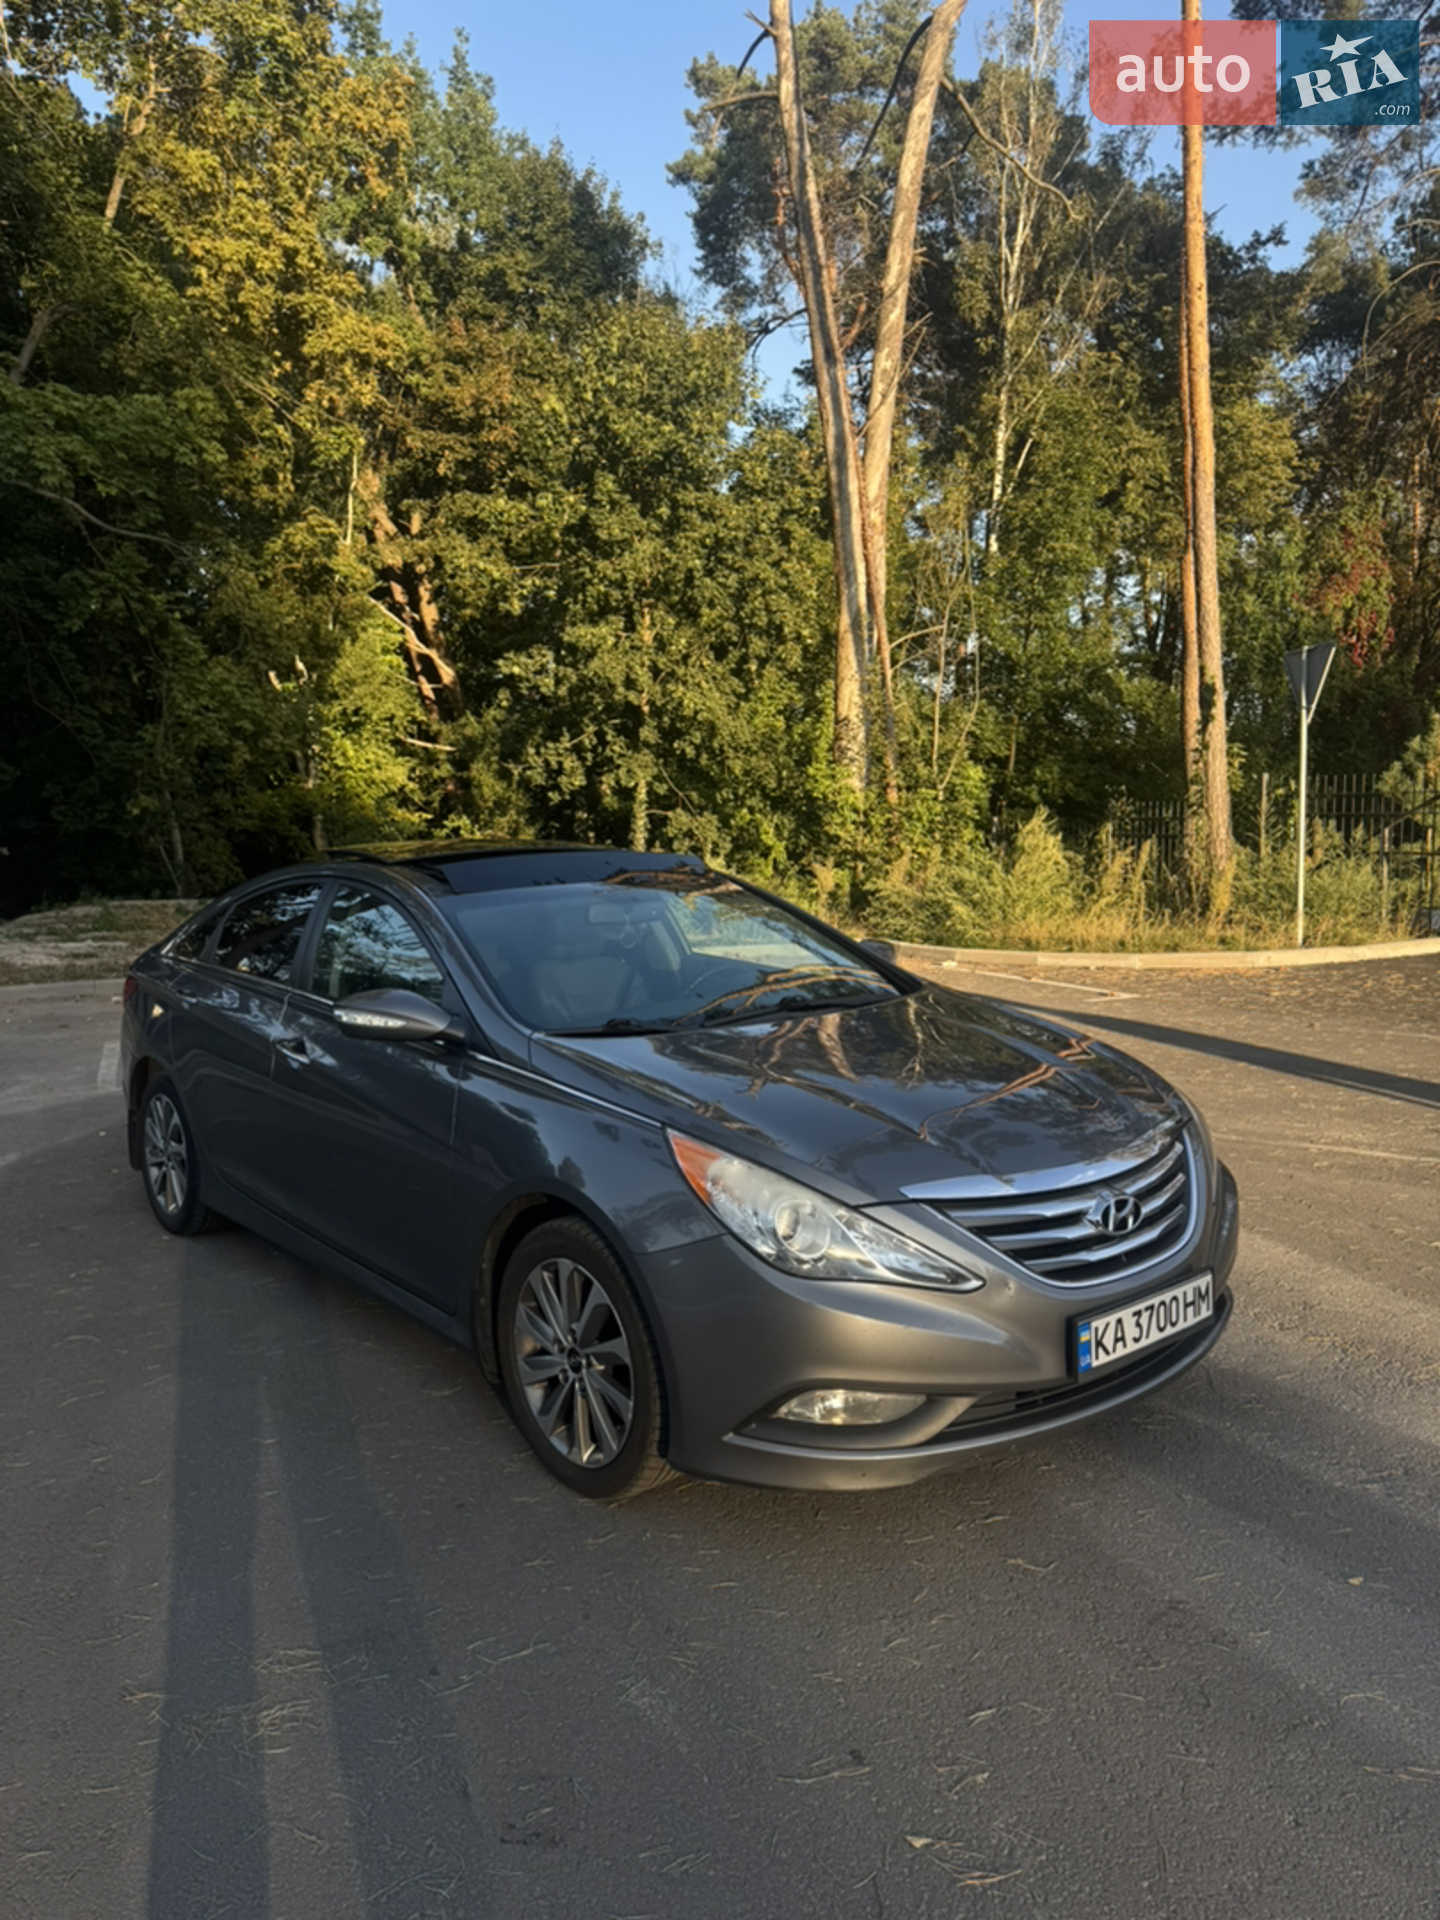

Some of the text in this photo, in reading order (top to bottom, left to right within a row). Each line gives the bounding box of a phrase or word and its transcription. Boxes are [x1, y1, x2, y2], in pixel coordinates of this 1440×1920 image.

[1094, 1280, 1211, 1361] KA 3700 HM
